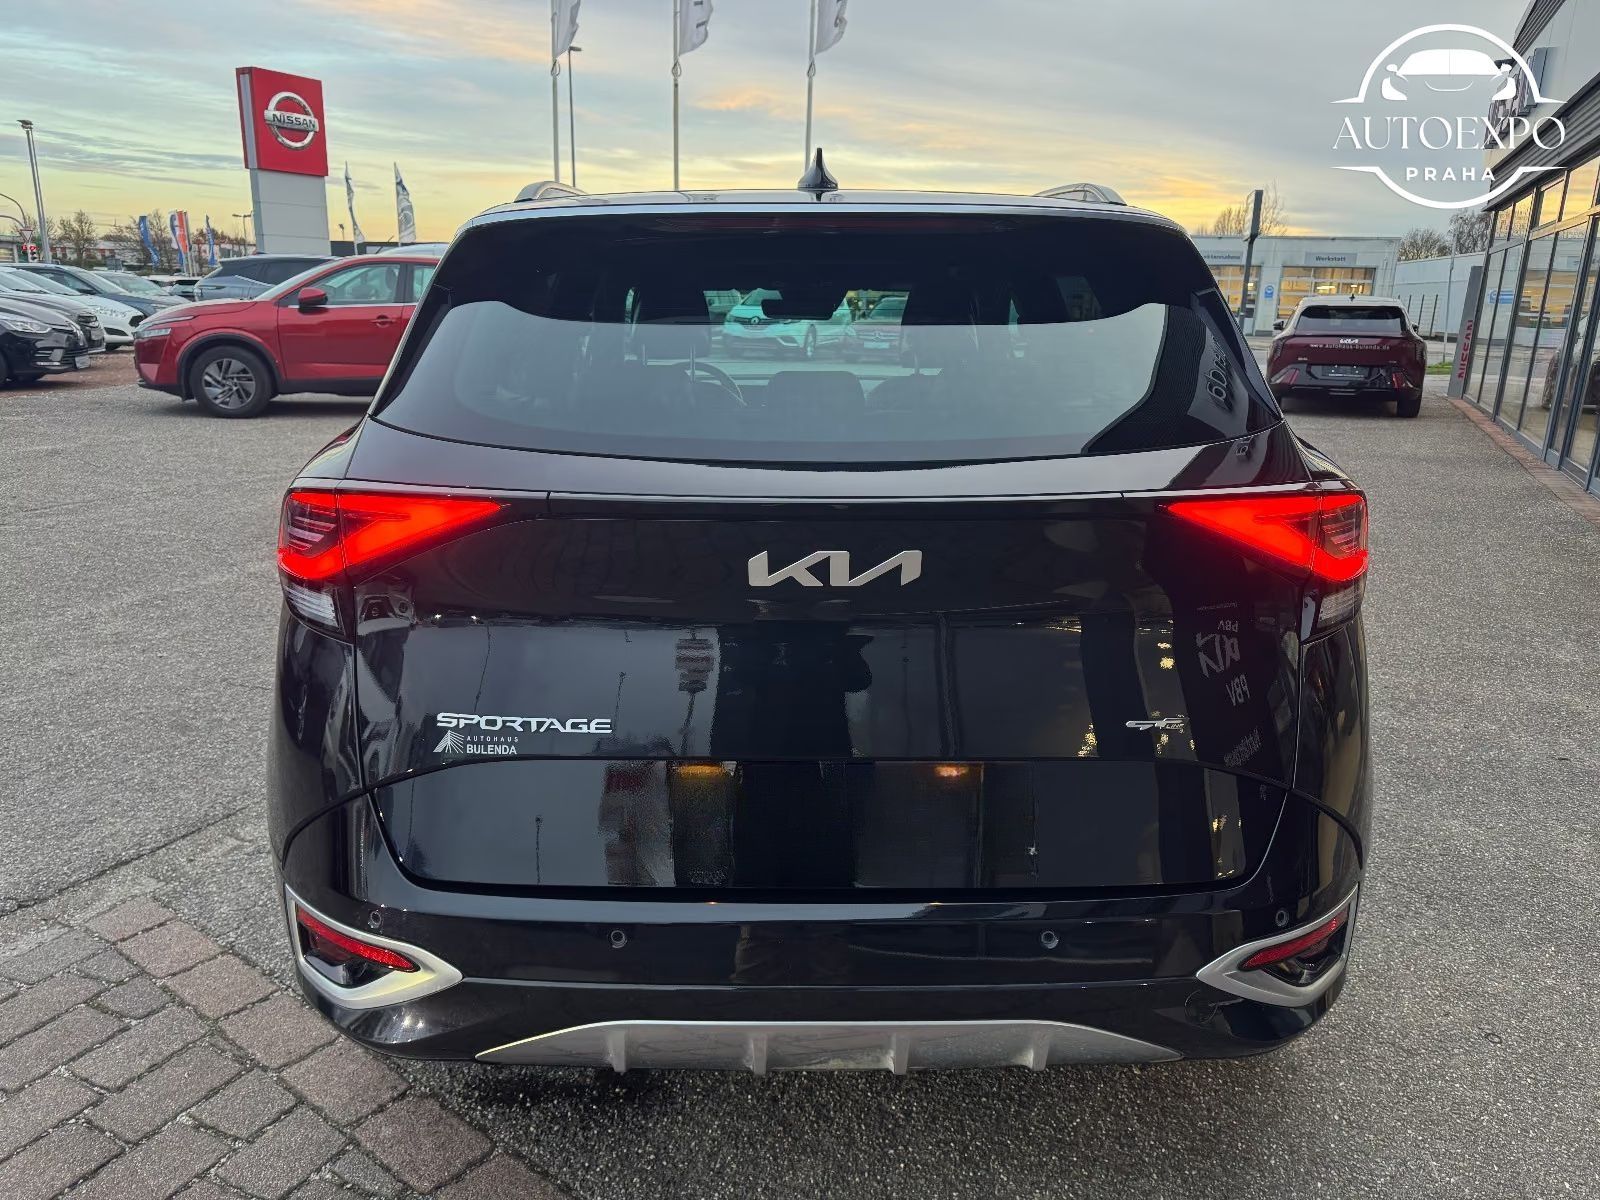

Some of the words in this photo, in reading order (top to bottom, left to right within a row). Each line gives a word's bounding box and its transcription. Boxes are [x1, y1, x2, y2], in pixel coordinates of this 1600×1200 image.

[272, 113, 316, 128] NISSAN
[748, 550, 922, 587] KIA
[437, 712, 613, 734] SPORTAGE
[466, 744, 517, 755] BULENDA
